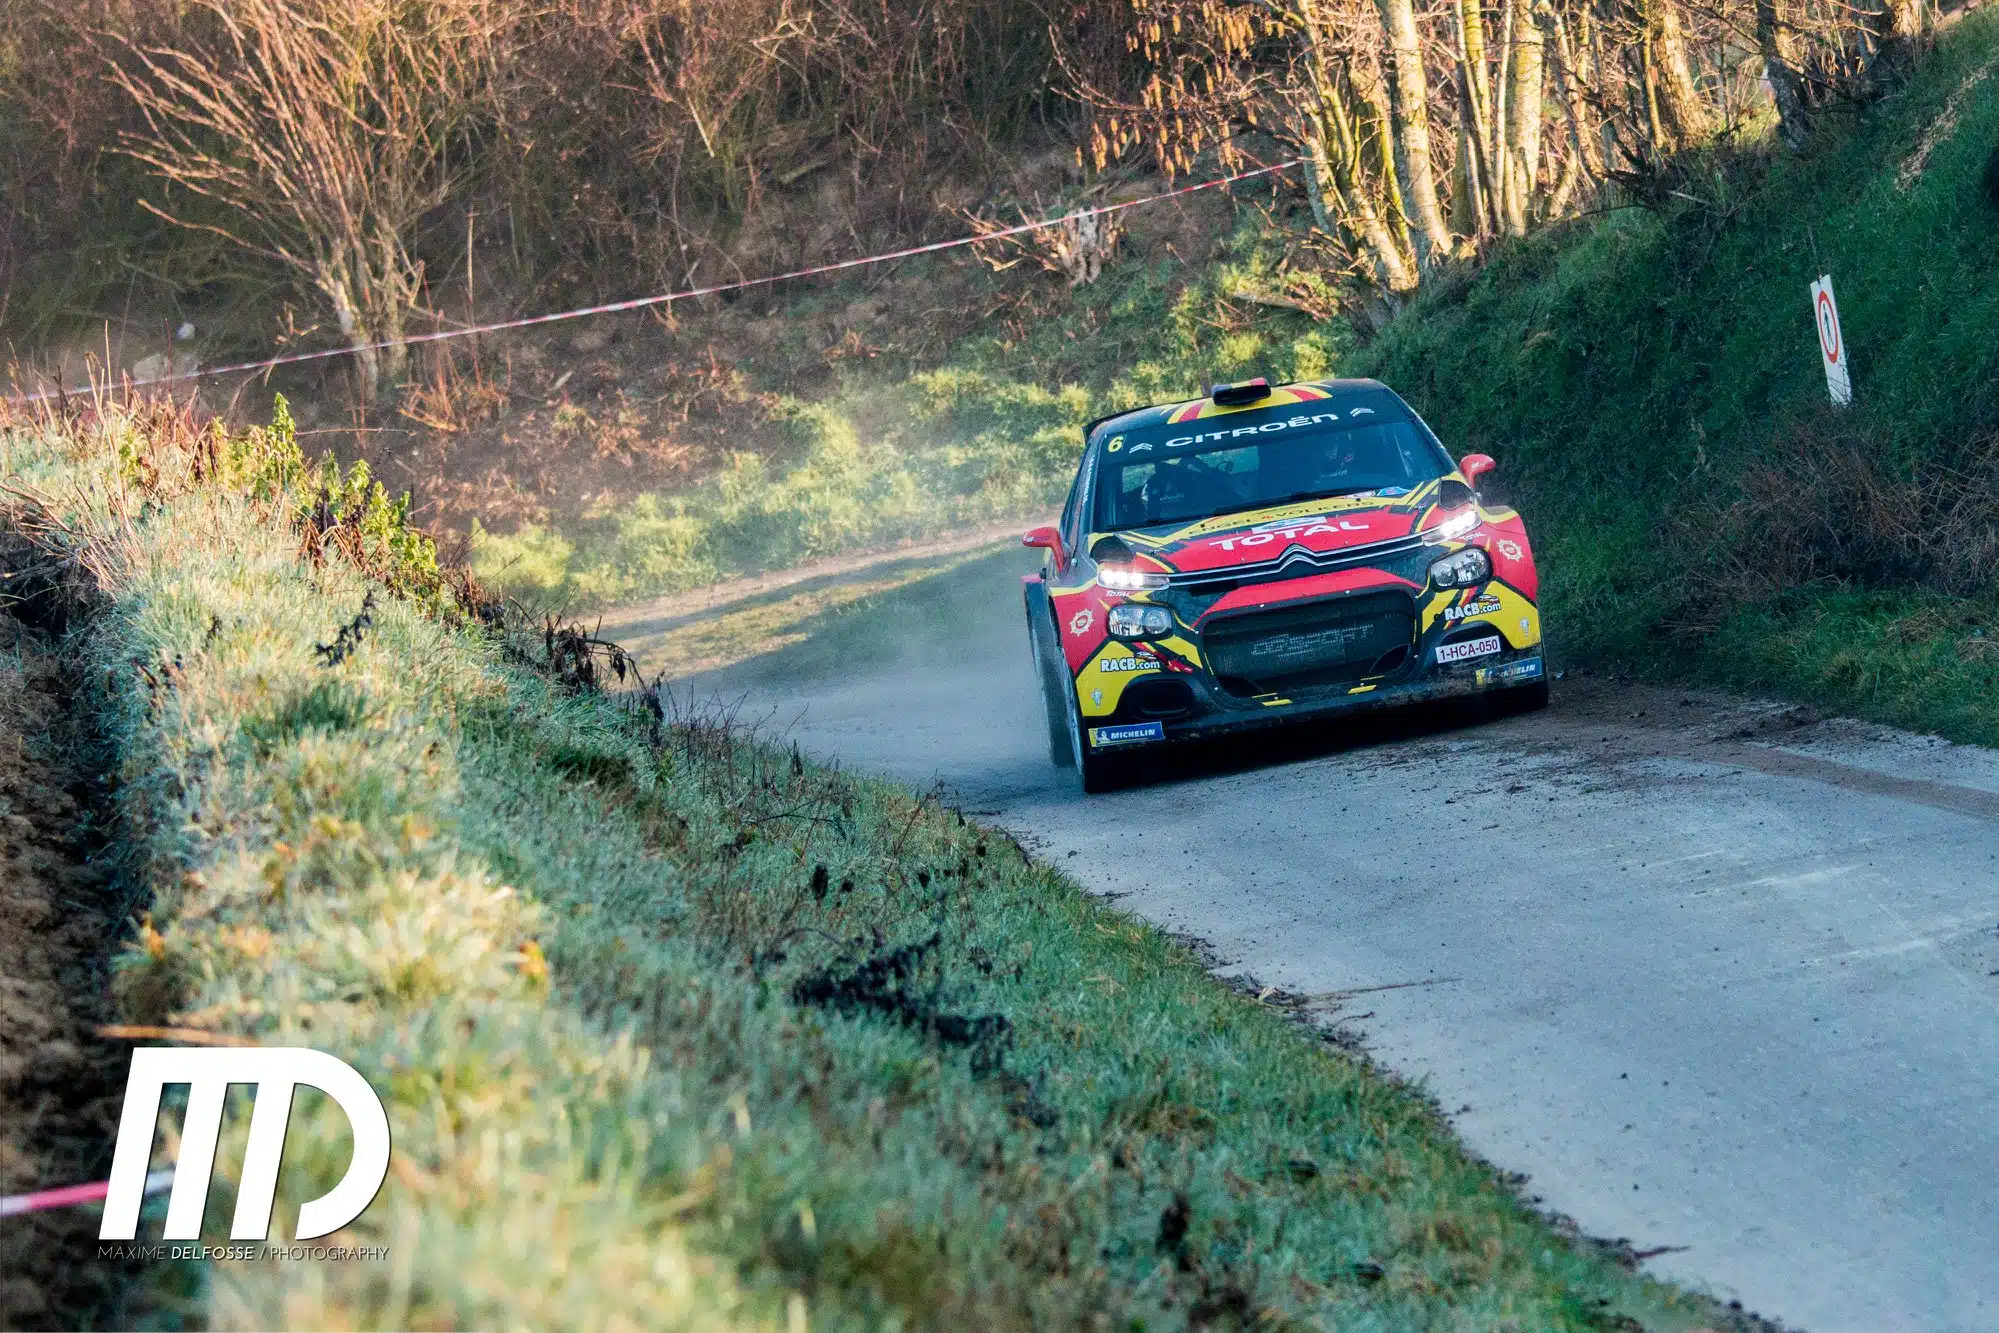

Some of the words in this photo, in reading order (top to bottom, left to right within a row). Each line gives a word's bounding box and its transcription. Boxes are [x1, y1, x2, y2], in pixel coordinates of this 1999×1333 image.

[1165, 413, 1339, 447] CITROËN
[1107, 435, 1124, 453] 6
[1209, 521, 1370, 551] TOTAL
[1106, 590, 1130, 598] TOTAL
[1443, 601, 1502, 621] RACB.com
[1439, 639, 1498, 661] 1-HCA-050
[1100, 657, 1160, 673] RACB.com
[1110, 731, 1156, 740] MICHELIN
